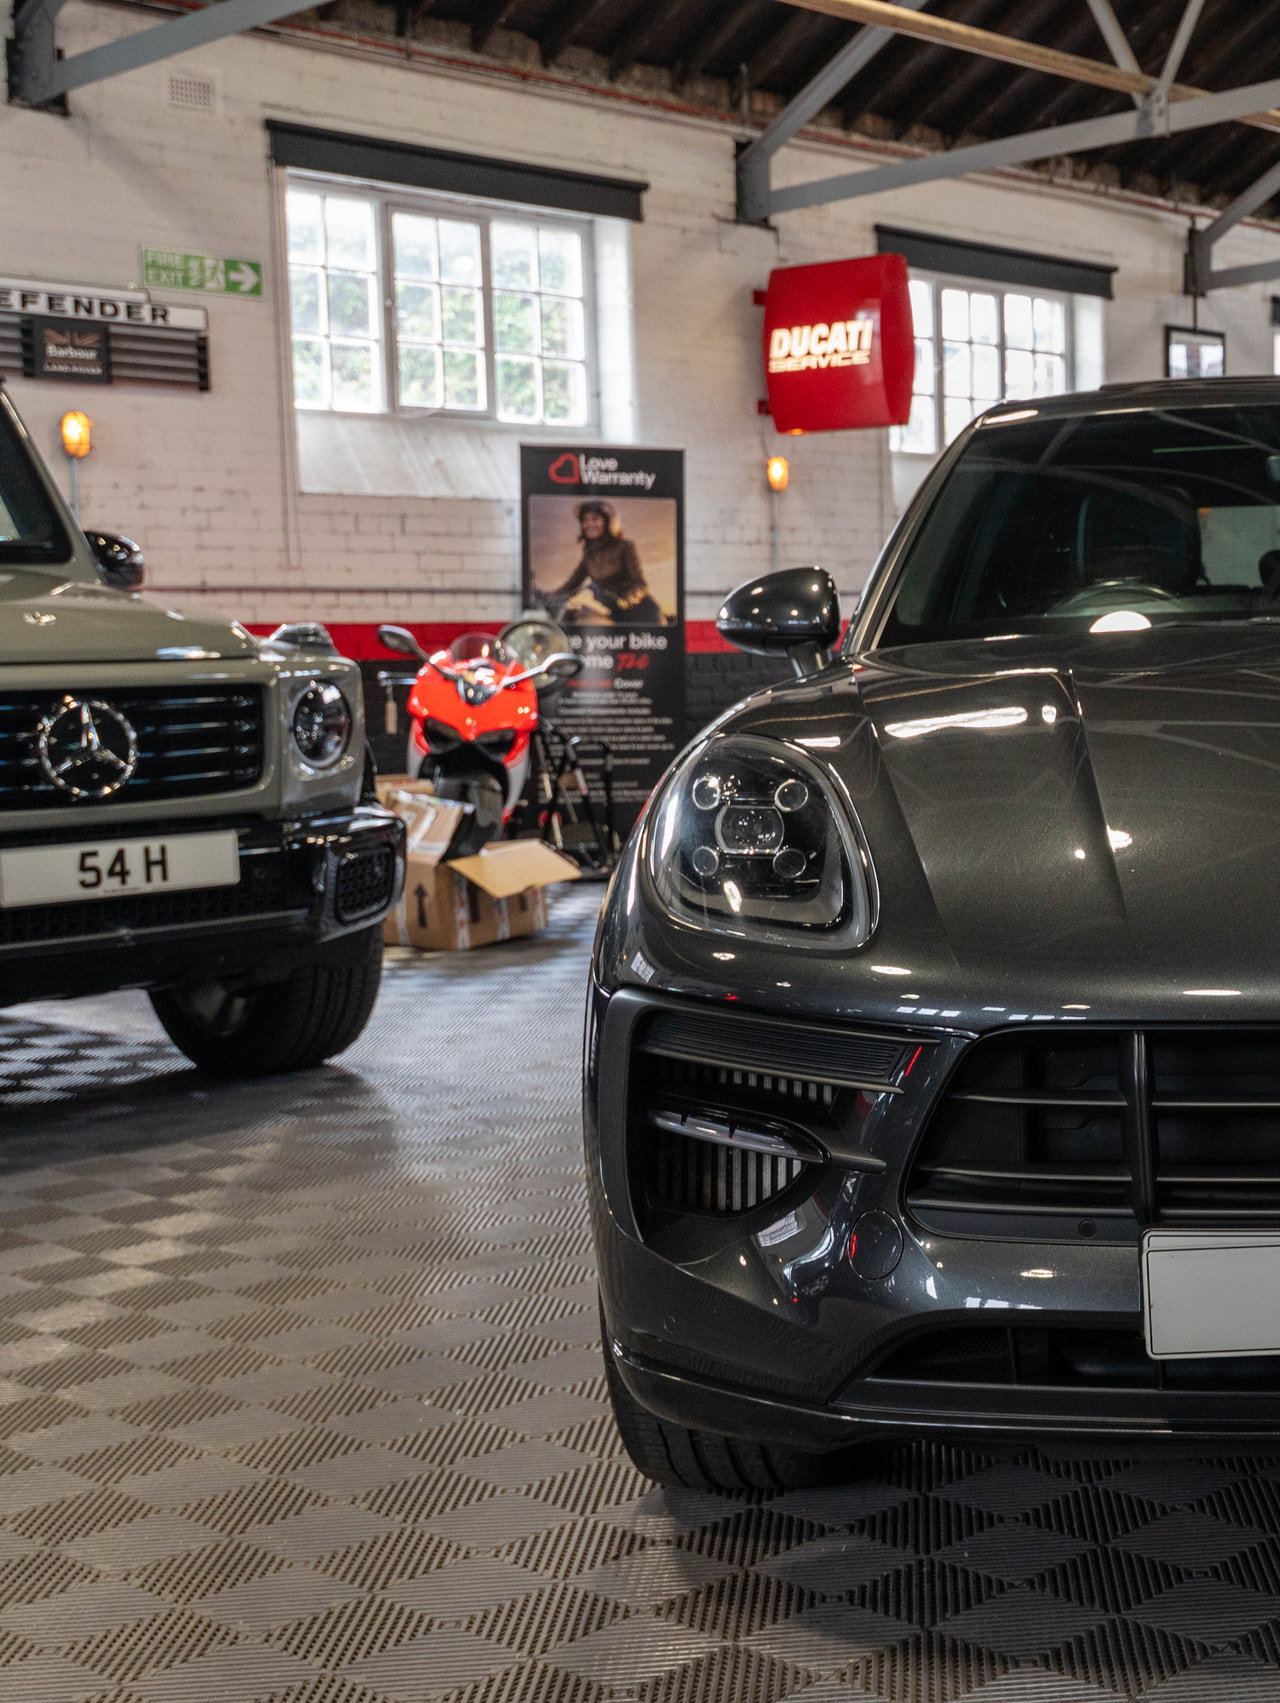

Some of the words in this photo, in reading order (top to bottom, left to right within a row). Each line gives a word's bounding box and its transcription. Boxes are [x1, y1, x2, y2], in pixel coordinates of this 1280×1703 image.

[147, 251, 183, 268] FIRE
[149, 268, 182, 286] EXIT
[769, 319, 874, 359] DUCATI
[46, 343, 98, 359] Barbour
[768, 349, 871, 374] SERVICE
[579, 453, 618, 471] Love
[580, 469, 656, 490] Warranty
[586, 634, 627, 653] your
[629, 632, 668, 650] bike
[613, 677, 644, 690] Cover
[79, 848, 130, 889] 54
[144, 844, 168, 884] H
